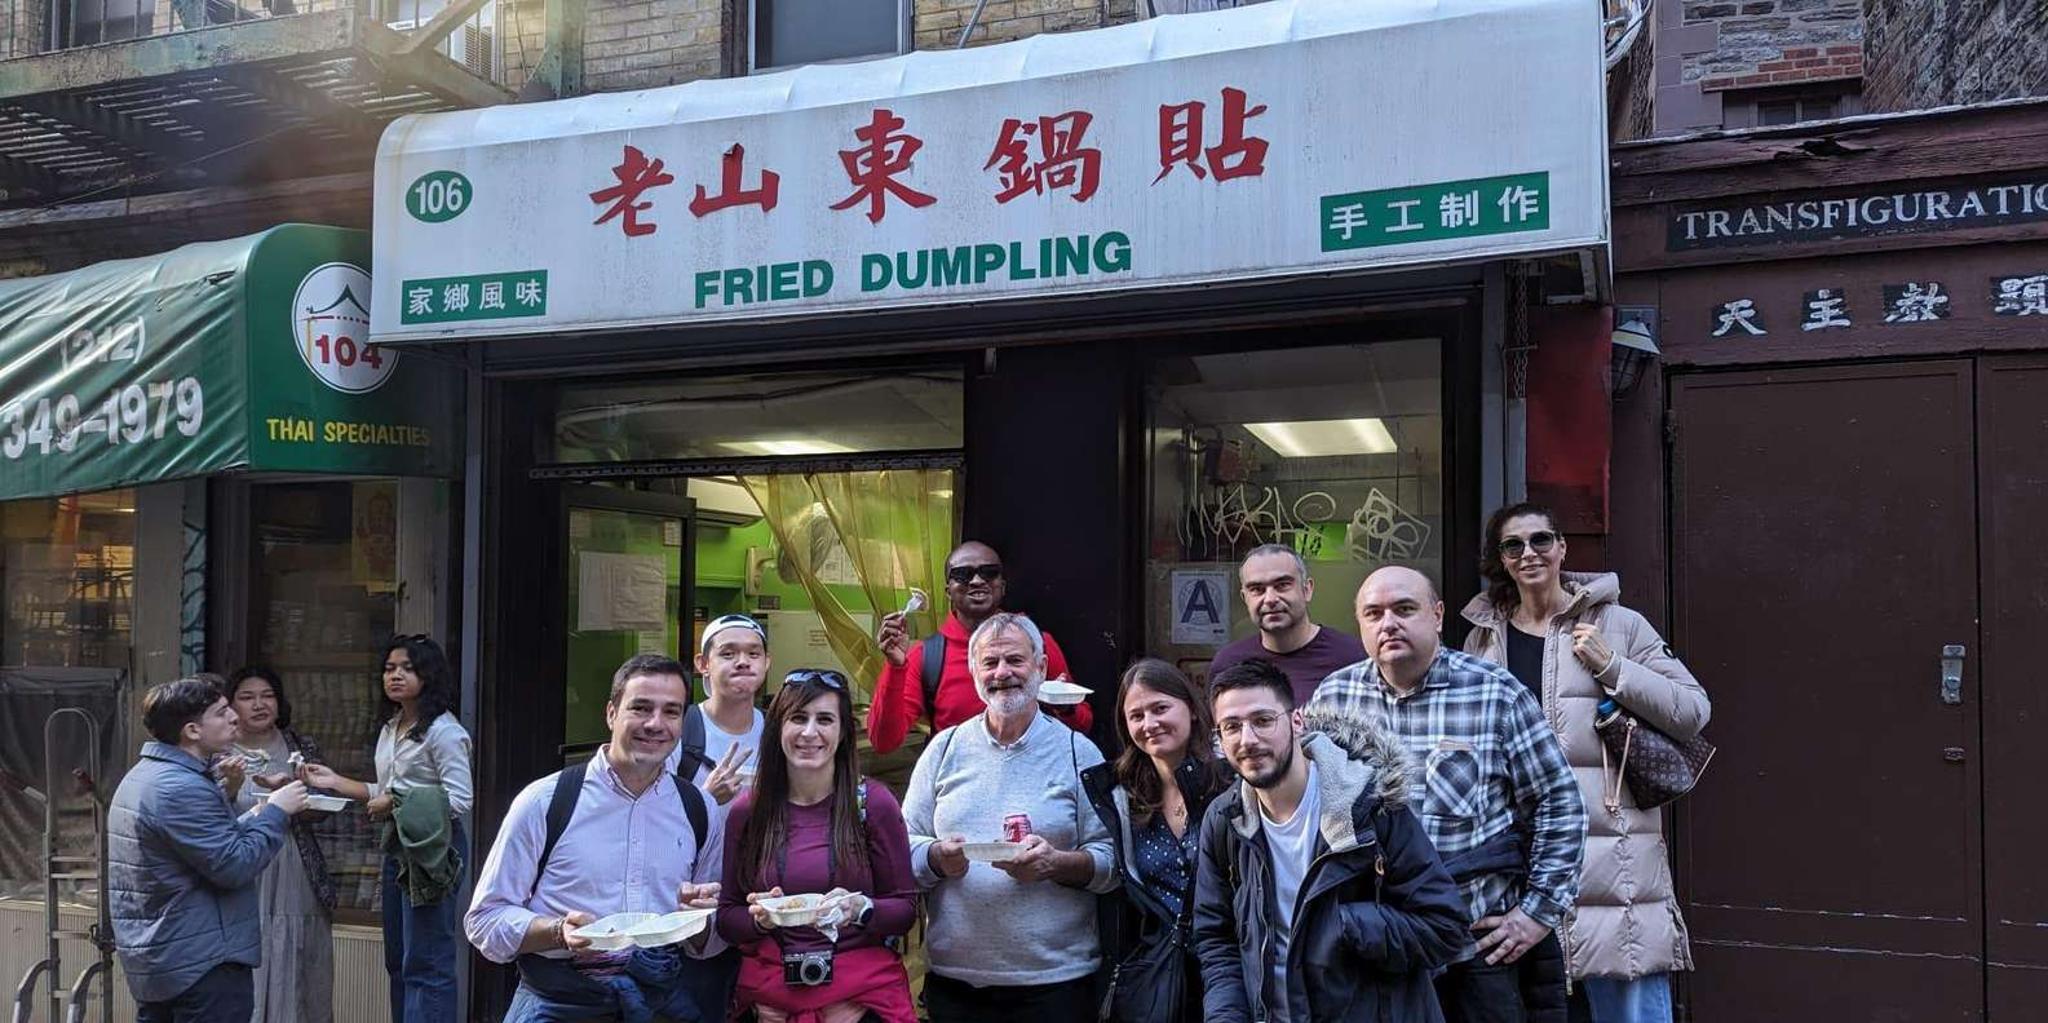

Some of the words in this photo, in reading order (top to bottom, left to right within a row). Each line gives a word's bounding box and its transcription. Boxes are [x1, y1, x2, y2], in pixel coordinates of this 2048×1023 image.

[589, 86, 1270, 238] 老山東鍋貼
[414, 175, 464, 217] 106
[1329, 185, 1540, 242] 手工制作
[694, 258, 835, 310] FRIED
[861, 230, 1132, 293] DUMPLING
[407, 278, 543, 316] 家鄉風味
[315, 334, 384, 370] 104
[3, 376, 204, 460] 349-1979
[266, 416, 315, 443] THAI
[323, 420, 432, 447] SPECIALTIES
[1180, 579, 1221, 624] A
